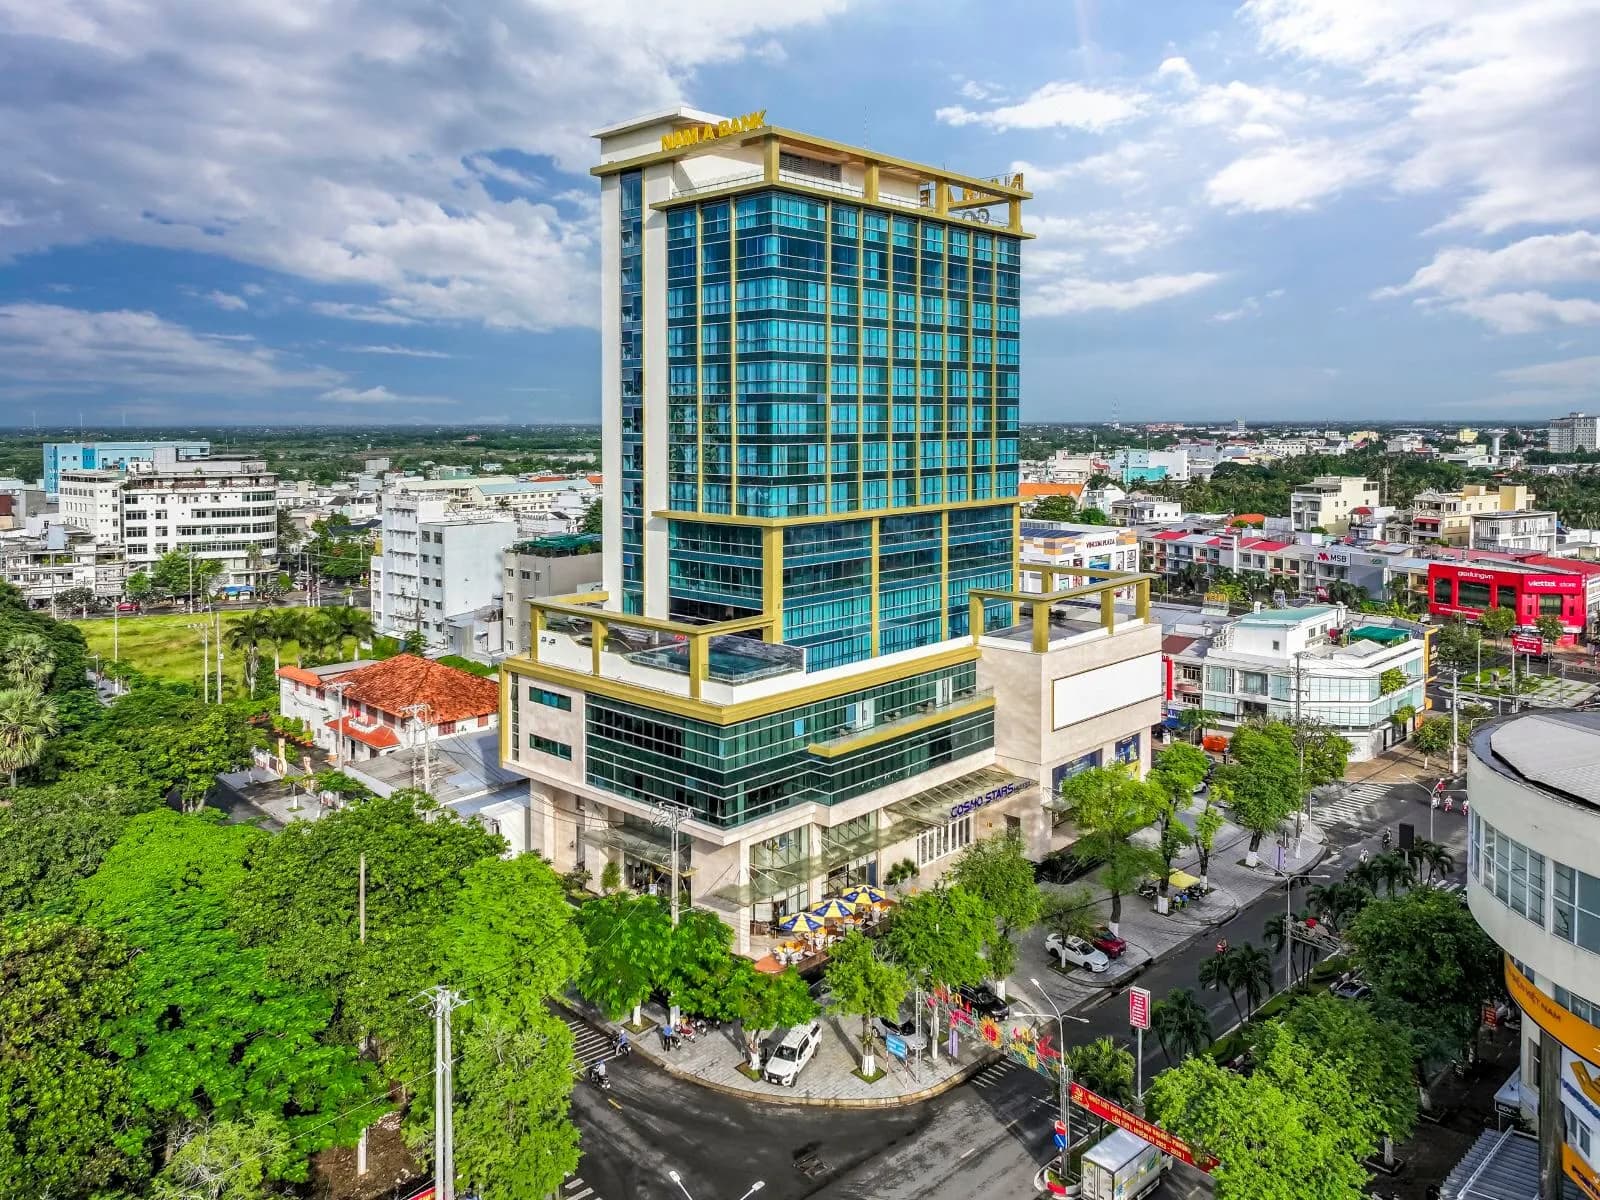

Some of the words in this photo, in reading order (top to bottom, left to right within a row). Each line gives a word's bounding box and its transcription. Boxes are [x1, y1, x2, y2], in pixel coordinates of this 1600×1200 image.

[661, 126, 698, 151] NAM
[719, 110, 766, 137] BANK
[1103, 538, 1115, 546] PLAZA
[1330, 554, 1347, 563] MSB
[1527, 580, 1556, 588] viettel
[950, 796, 983, 818] COSMO
[985, 783, 1014, 804] STARS
